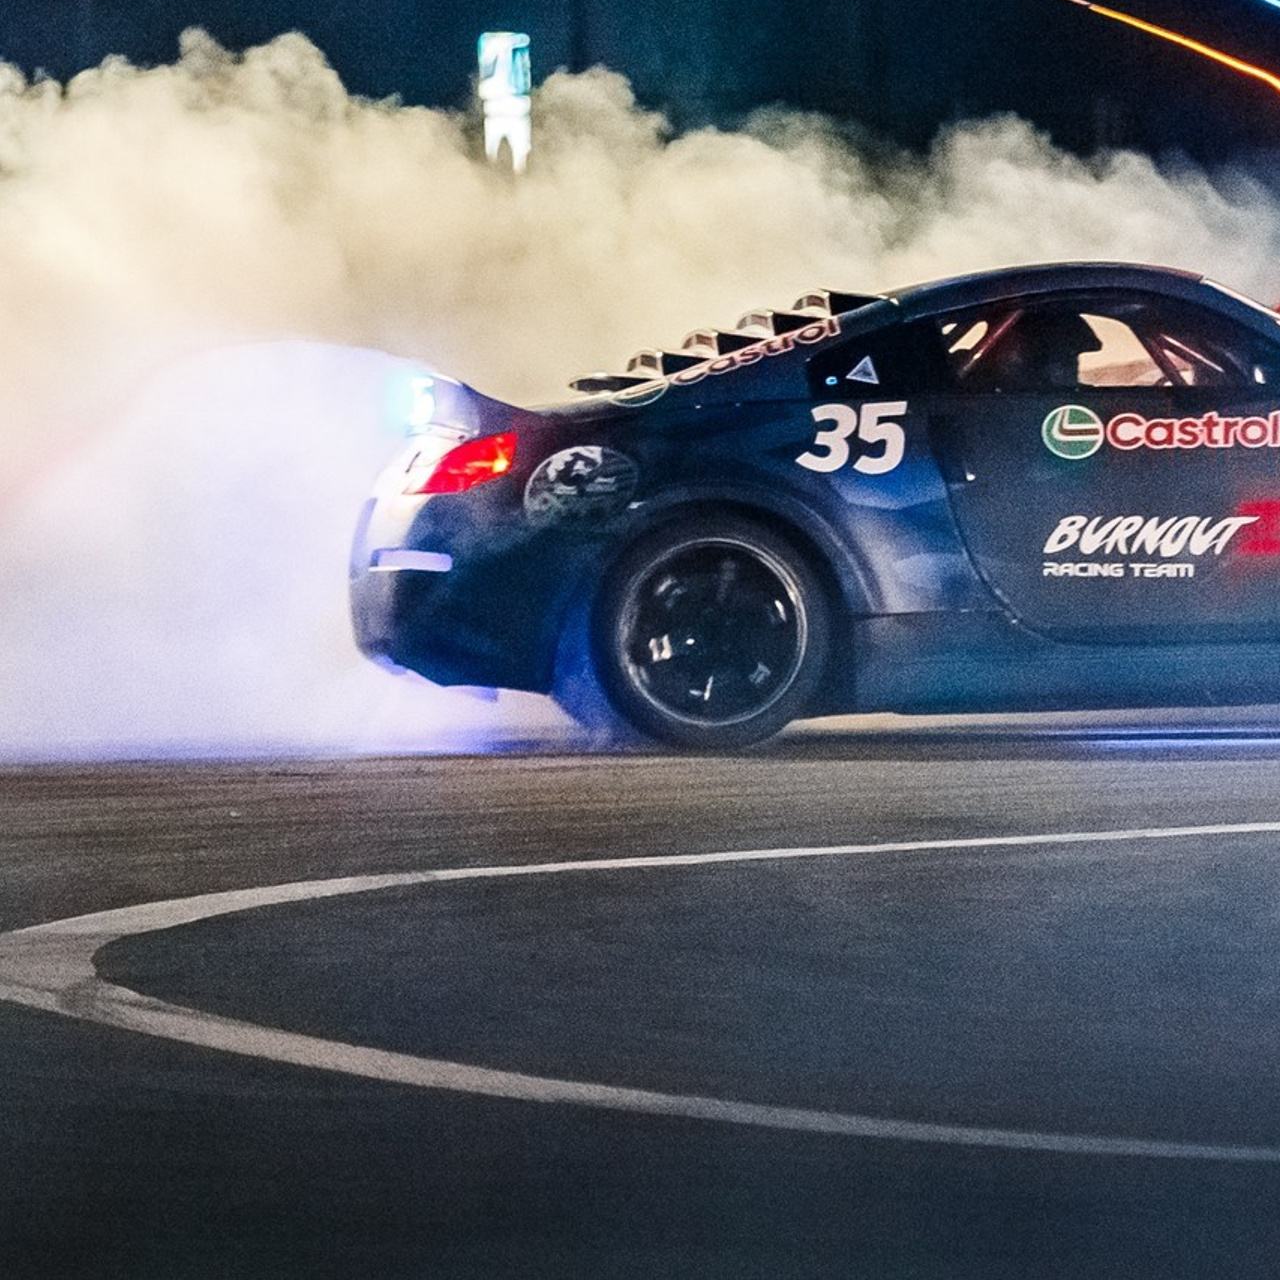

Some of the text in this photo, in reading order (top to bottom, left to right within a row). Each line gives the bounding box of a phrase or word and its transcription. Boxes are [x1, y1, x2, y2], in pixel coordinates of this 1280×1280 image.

[671, 317, 841, 386] Castrol
[795, 401, 908, 475] 35
[1042, 515, 1261, 557] BURNOUT
[1042, 562, 1195, 578] RACING TEAM
